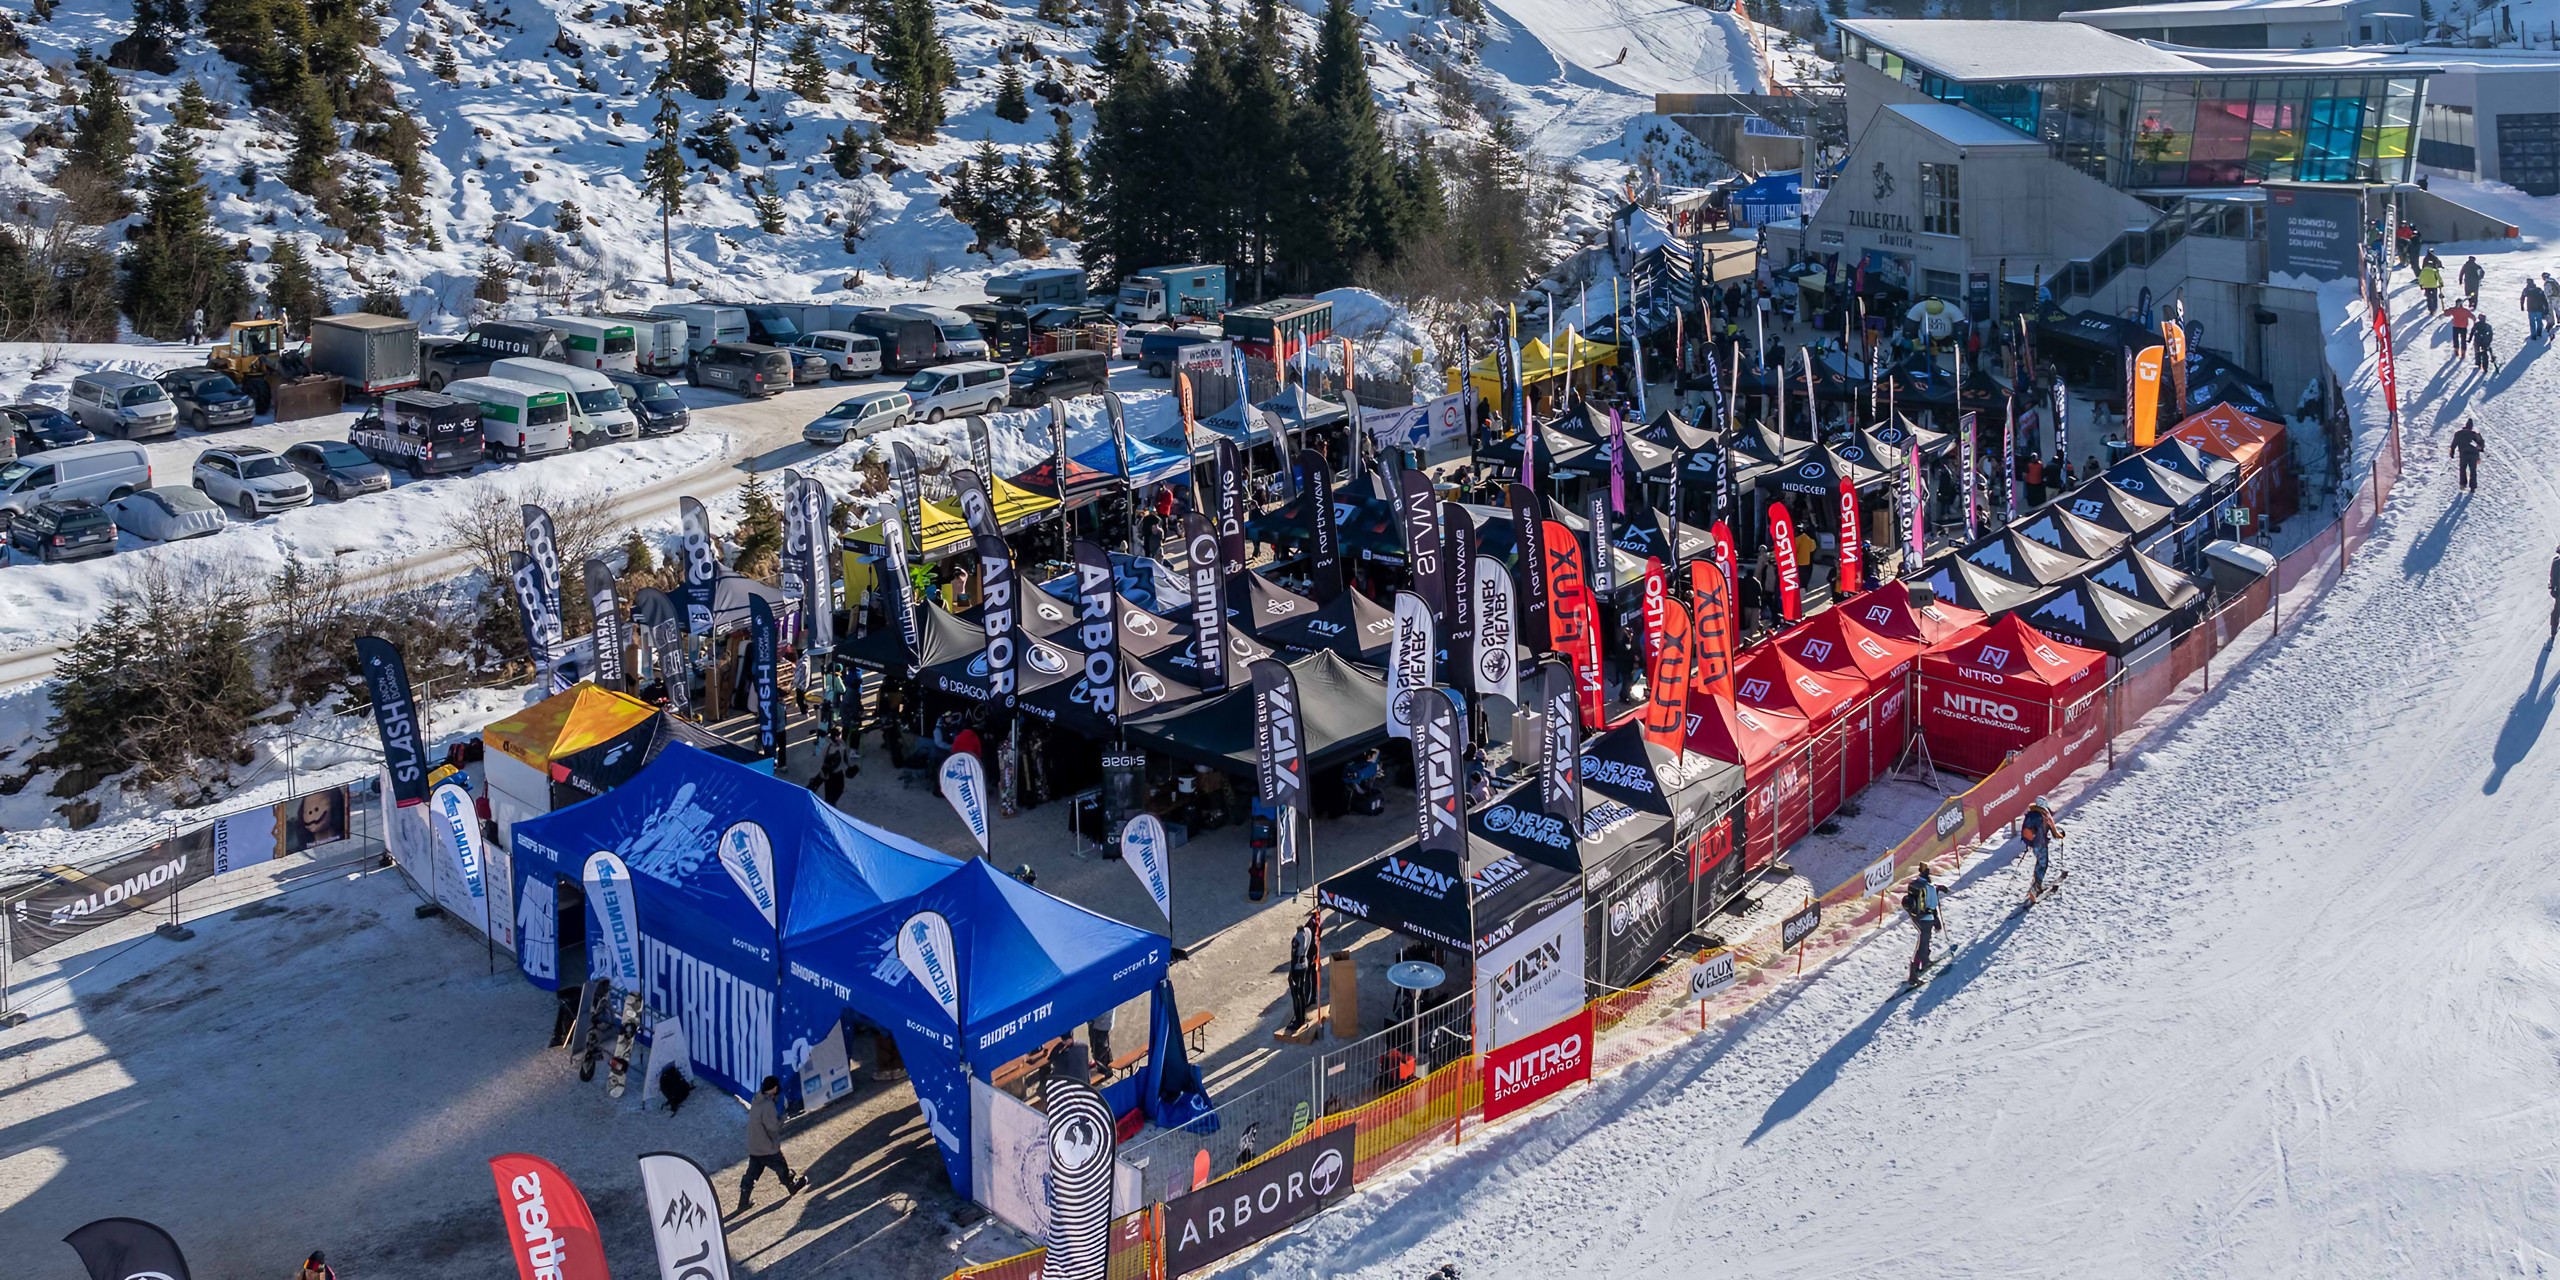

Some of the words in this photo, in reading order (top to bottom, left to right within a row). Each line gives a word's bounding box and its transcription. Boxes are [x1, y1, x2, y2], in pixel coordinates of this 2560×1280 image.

[1849, 210, 1912, 233] ZILLERTAL
[1879, 233, 1913, 248] shuttle
[482, 337, 529, 354] BURTON
[349, 429, 427, 460] northwave
[1782, 482, 1826, 497] NIDECKER
[1313, 470, 1328, 553] northwave
[1520, 506, 1542, 597] northwave
[1453, 529, 1468, 624] northwave
[981, 555, 1017, 700] ARBOR
[1077, 563, 1116, 713] ARBOR
[377, 676, 390, 701] SNOW
[384, 664, 399, 699] BOARDS
[1958, 667, 2003, 686] NITRO
[758, 664, 774, 746] SLASH
[1944, 691, 2018, 722] NITRO
[382, 700, 420, 783] SLASH
[1595, 770, 1654, 793] SUMMER
[1602, 760, 1646, 780] NEVER
[1510, 823, 1571, 850] SUMMER
[1517, 813, 1564, 834] NEVER
[216, 819, 229, 875] NIDECKER
[518, 833, 538, 854] SHOPS
[50, 855, 188, 926] SALOMON
[1377, 872, 1422, 894] PROTECTIVE
[1404, 920, 1449, 944] PROTECTIVE
[790, 961, 820, 987] SHOPS
[832, 980, 852, 1001] TRY
[1706, 958, 1733, 983] FLUX
[980, 1022, 1016, 1051] SHOPS
[1032, 1001, 1054, 1025] TRY
[1494, 1033, 1582, 1088] NITRO
[1494, 1057, 1582, 1101] SNOWBOARDS
[1179, 1172, 1304, 1253] ARBOR
